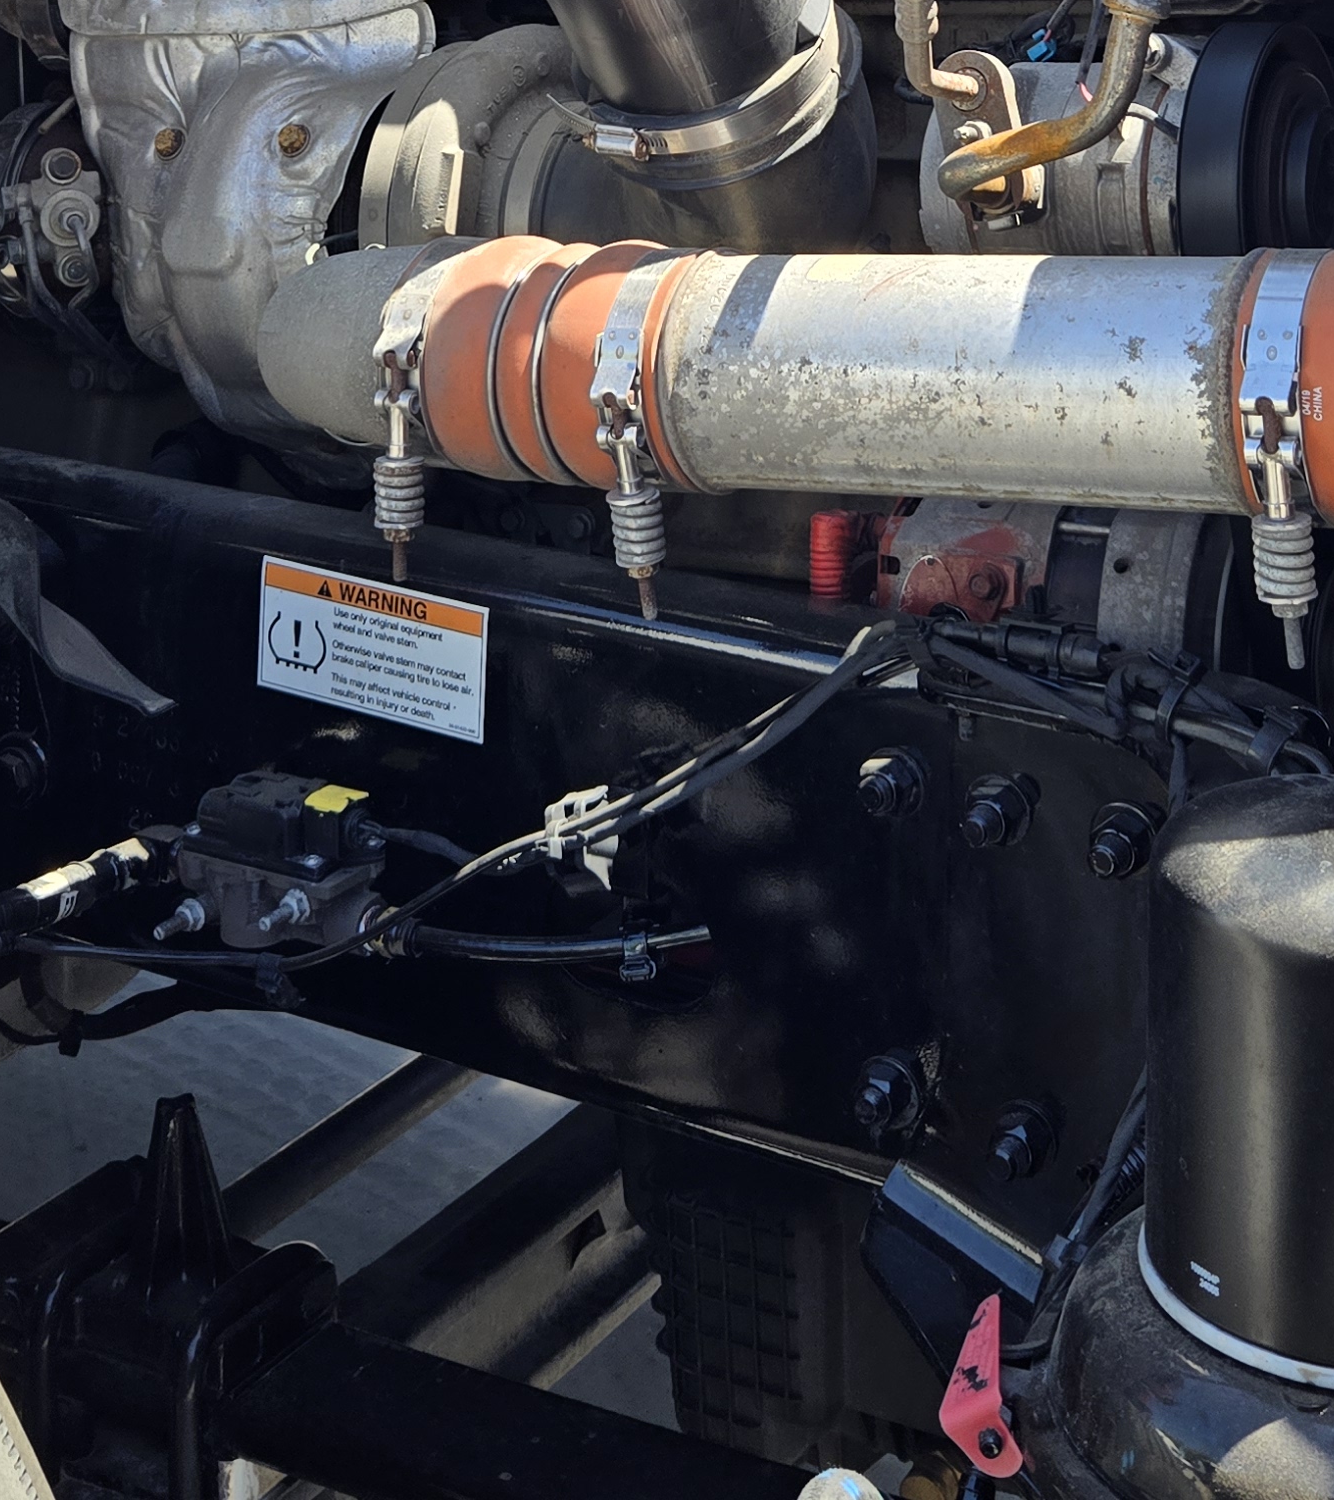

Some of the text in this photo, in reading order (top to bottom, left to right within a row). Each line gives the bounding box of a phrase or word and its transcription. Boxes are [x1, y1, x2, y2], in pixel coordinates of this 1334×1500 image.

[1301, 390, 1311, 416] 04/19
[1313, 386, 1323, 422] CHINA
[339, 582, 428, 620] WARNING
[333, 607, 443, 642] Use only original equipment
[333, 621, 419, 650] wheel and valve stem.
[331, 652, 475, 696] brake caliper causing tire to lose air.
[332, 639, 467, 682] Otherwise valve stem may contact
[331, 672, 451, 711] This may affect vehicle control
[331, 686, 435, 720] resulting in injury or death.
